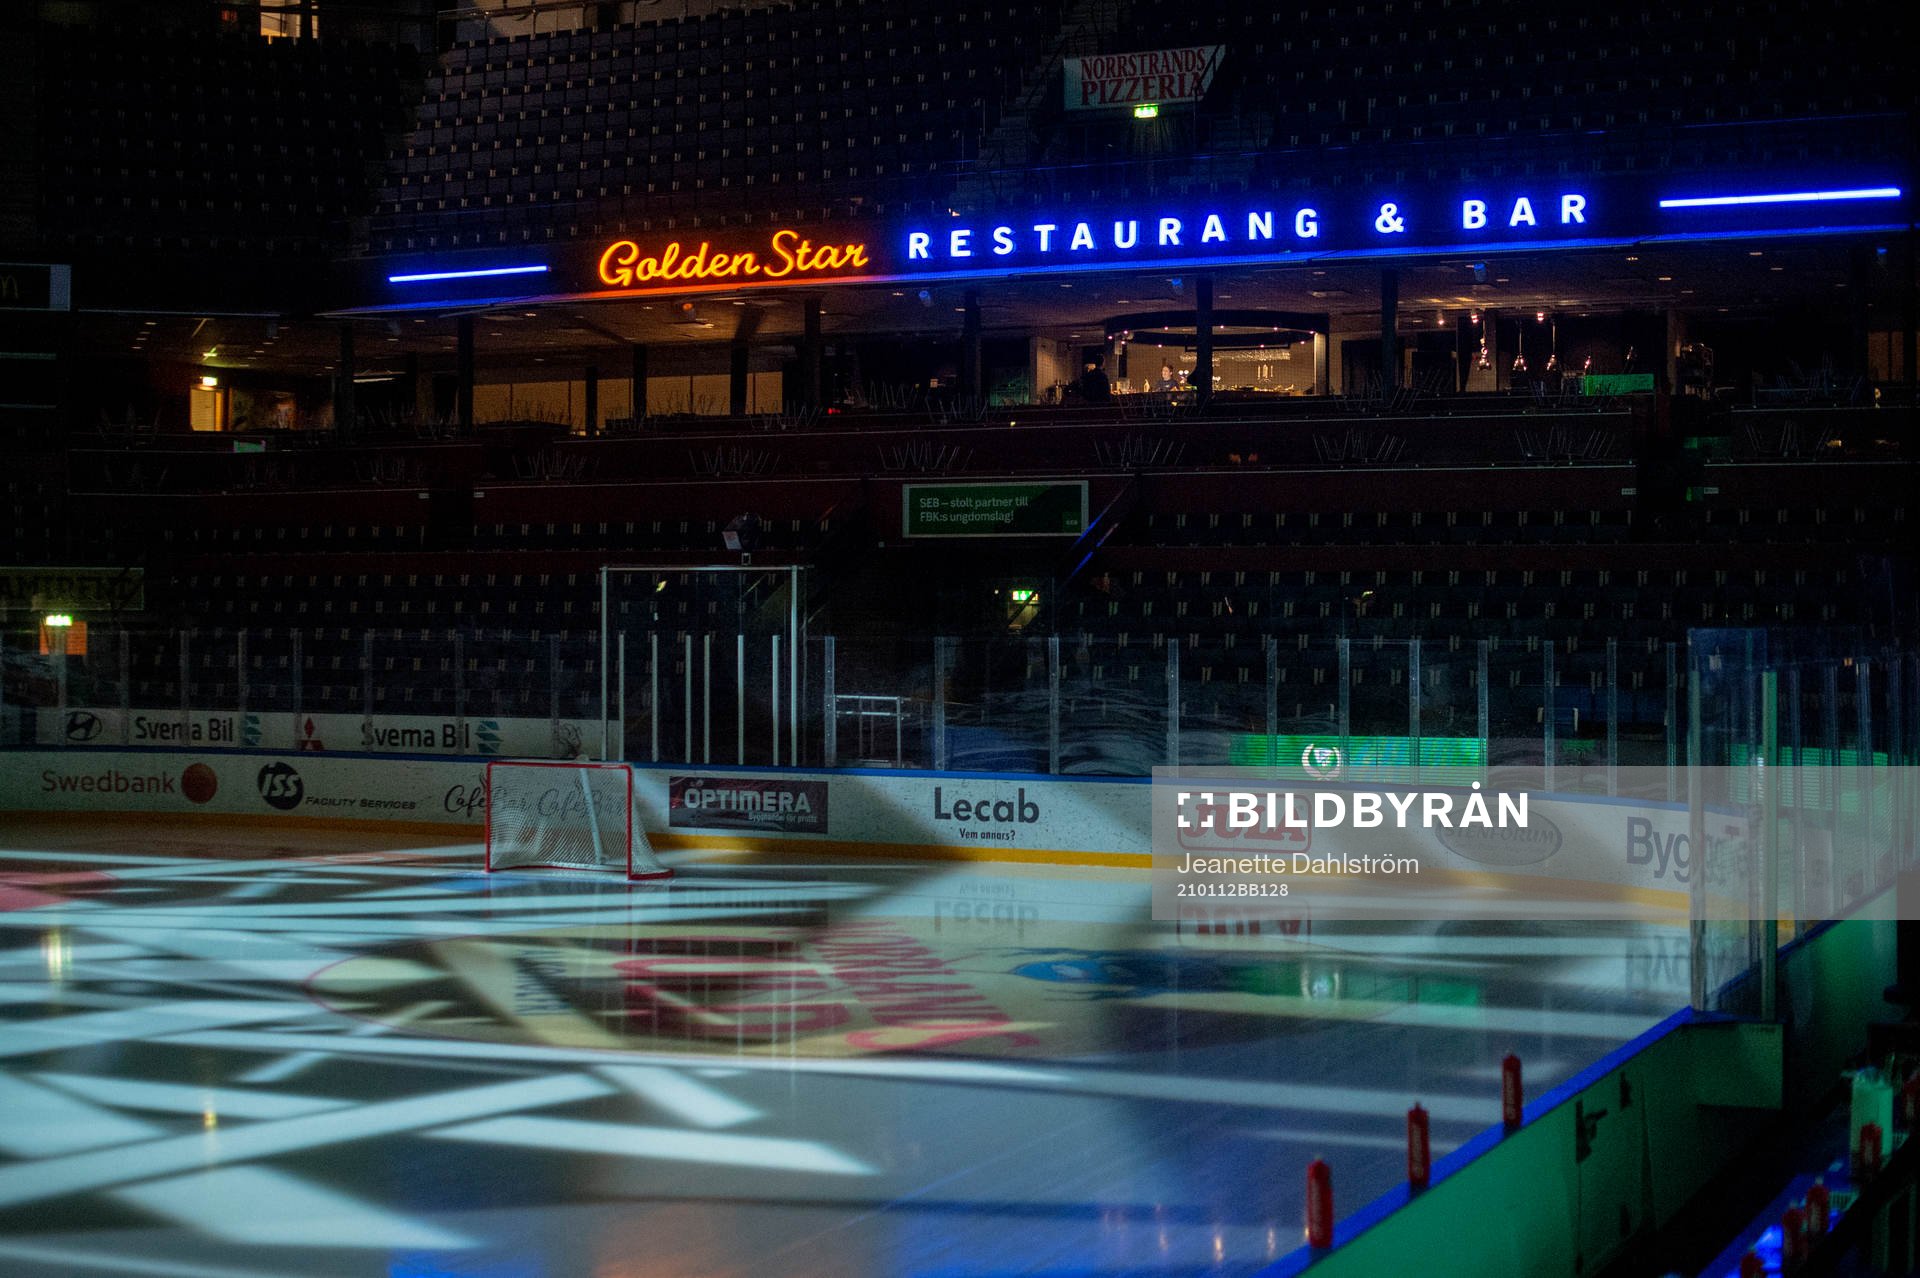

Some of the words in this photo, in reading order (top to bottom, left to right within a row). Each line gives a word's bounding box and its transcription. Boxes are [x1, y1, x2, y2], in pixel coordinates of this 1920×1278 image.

[1081, 48, 1206, 80] NORRSTRANDS
[1081, 72, 1206, 106] PIZZERIA
[908, 208, 1320, 259] RESTAURANG
[1375, 203, 1404, 233] &
[1463, 194, 1587, 229] BAR
[599, 240, 760, 287] Golden
[764, 230, 869, 277] Star
[920, 497, 939, 508] SEB
[950, 497, 973, 508] stolt
[974, 497, 1013, 510] partner
[1015, 496, 1029, 507] till
[920, 511, 947, 523] FBK:s
[949, 510, 1014, 524] ungdomslag!
[208, 717, 233, 742] Bil
[42, 769, 175, 793] Swedbank
[262, 772, 300, 798] ISS
[305, 796, 356, 807] FACILITY
[360, 798, 416, 810] SERVICES
[934, 786, 1040, 823] Lecab
[959, 828, 978, 839] Vem
[980, 829, 1016, 841] annars?
